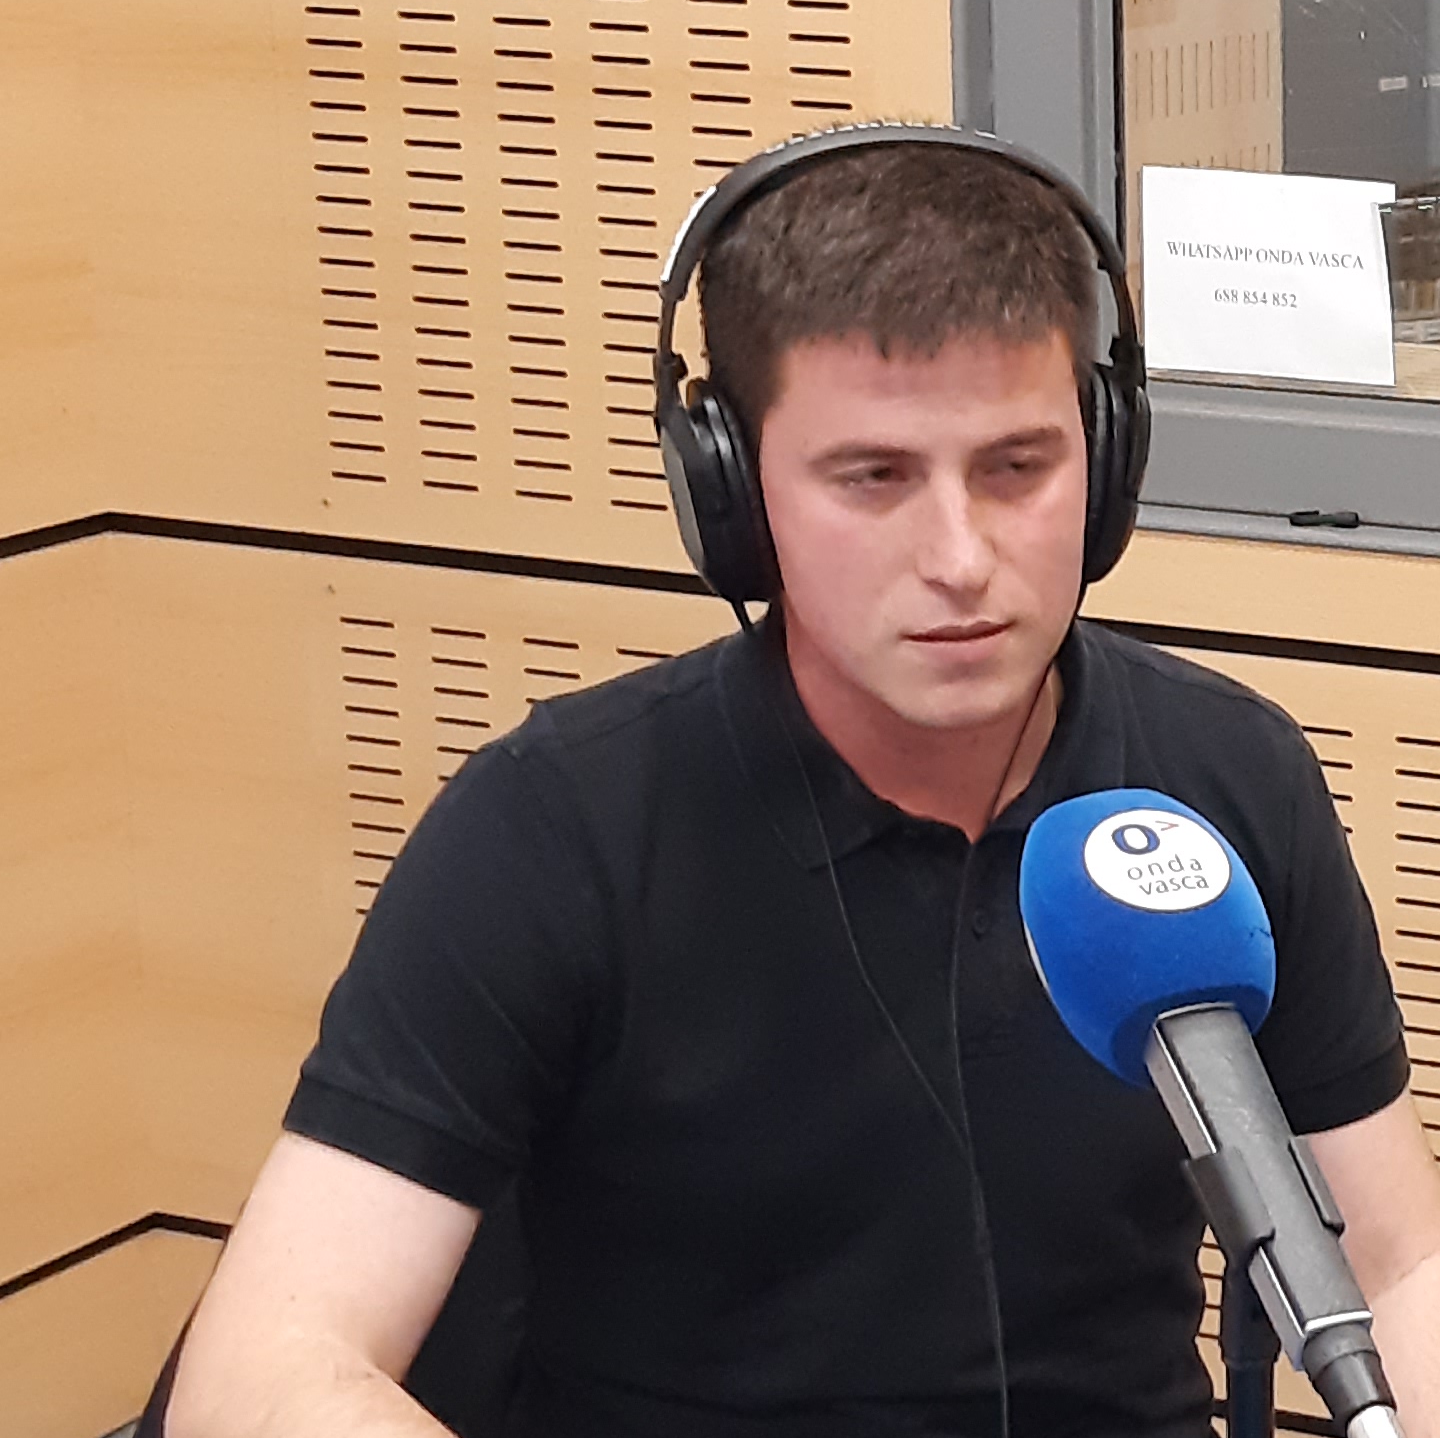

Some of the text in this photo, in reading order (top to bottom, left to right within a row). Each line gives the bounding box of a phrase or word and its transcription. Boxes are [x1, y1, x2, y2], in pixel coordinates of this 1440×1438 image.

[1166, 241, 1364, 270] WHATSAPP ONDA VASCA
[1126, 855, 1203, 881] onda
[1138, 871, 1209, 896] vasca
